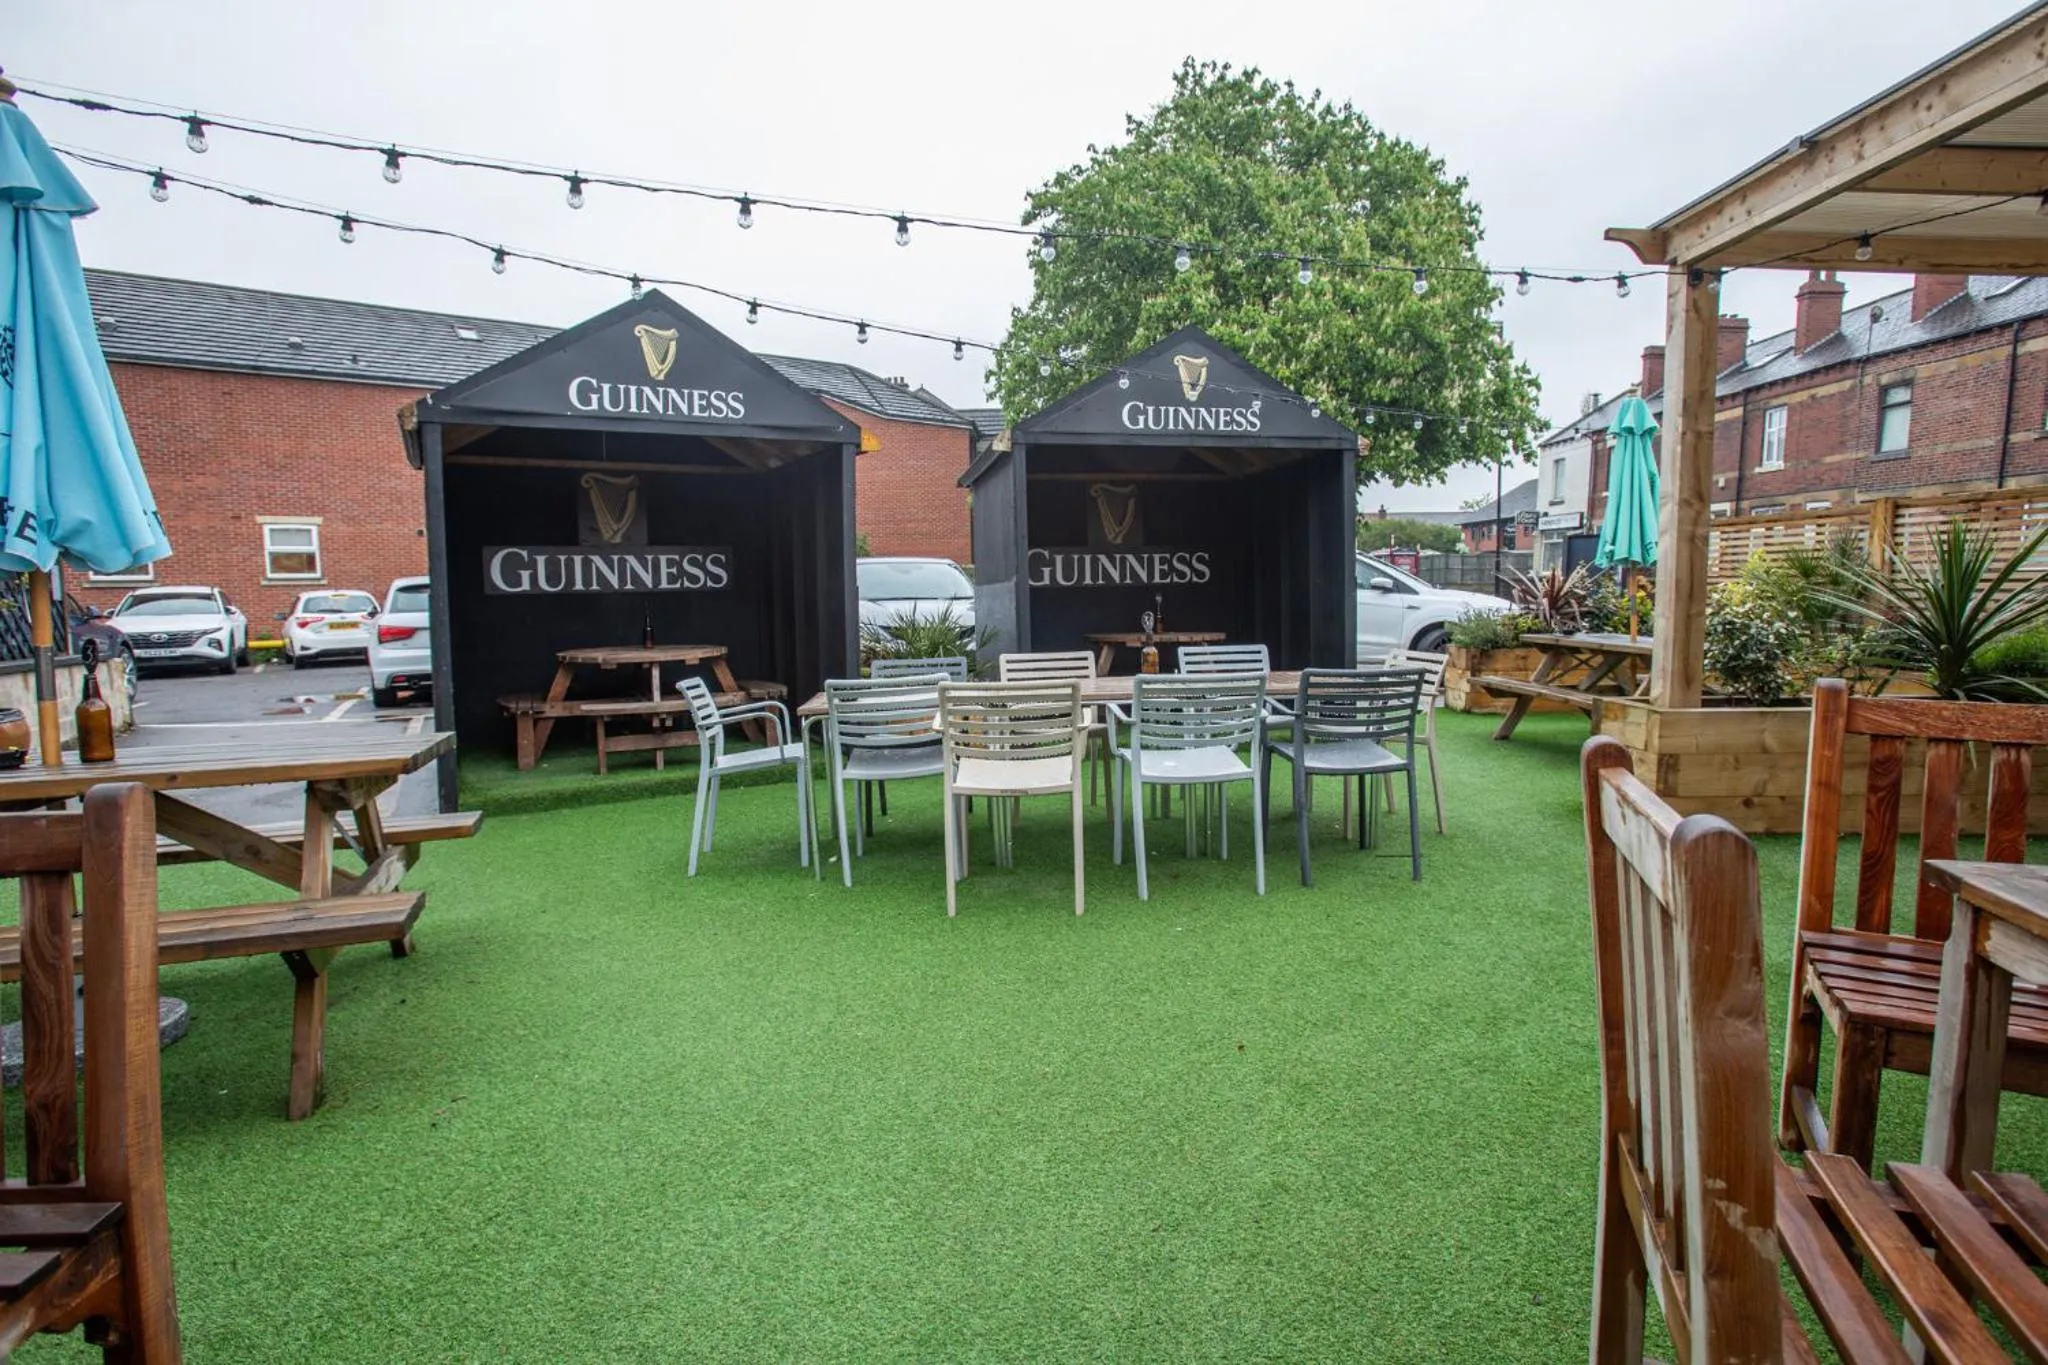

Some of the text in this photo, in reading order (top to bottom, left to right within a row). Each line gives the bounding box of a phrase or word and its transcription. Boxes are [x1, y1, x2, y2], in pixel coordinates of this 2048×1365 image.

[568, 376, 745, 419] GUINNESS
[1121, 401, 1261, 431] GUINNESS
[489, 548, 728, 592] GUINNESS
[1028, 548, 1211, 586] GUINNESS
